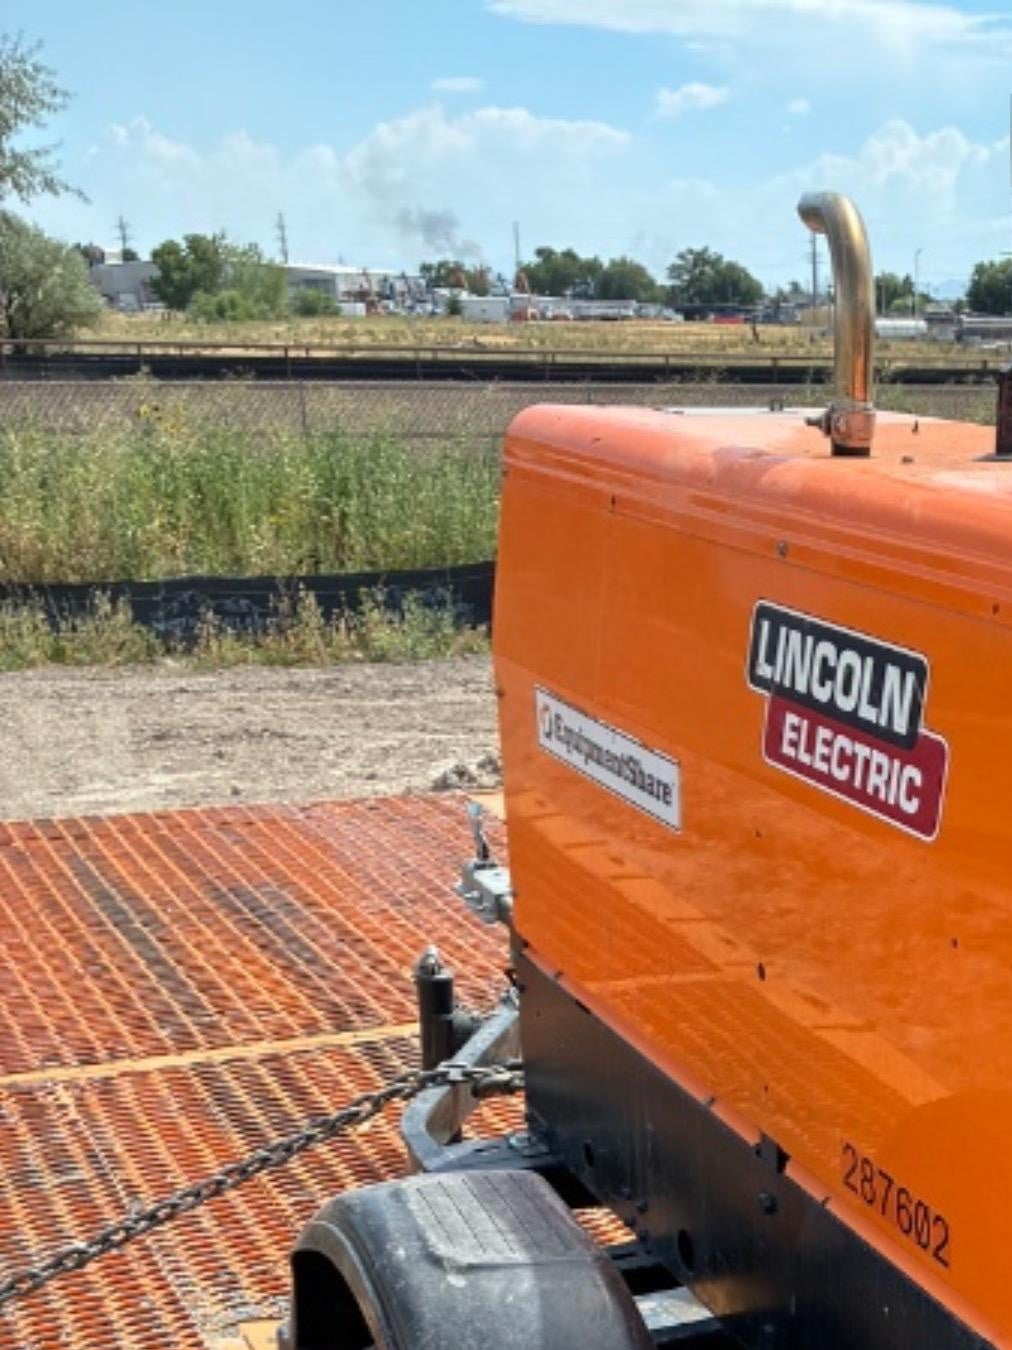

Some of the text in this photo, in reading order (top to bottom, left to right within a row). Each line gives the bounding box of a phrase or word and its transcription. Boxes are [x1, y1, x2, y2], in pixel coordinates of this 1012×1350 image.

[755, 616, 918, 736] LINCOLN
[554, 713, 673, 806] EquipmentShare
[781, 718, 924, 815] ELECTRIC
[842, 1141, 950, 1269] 287602
